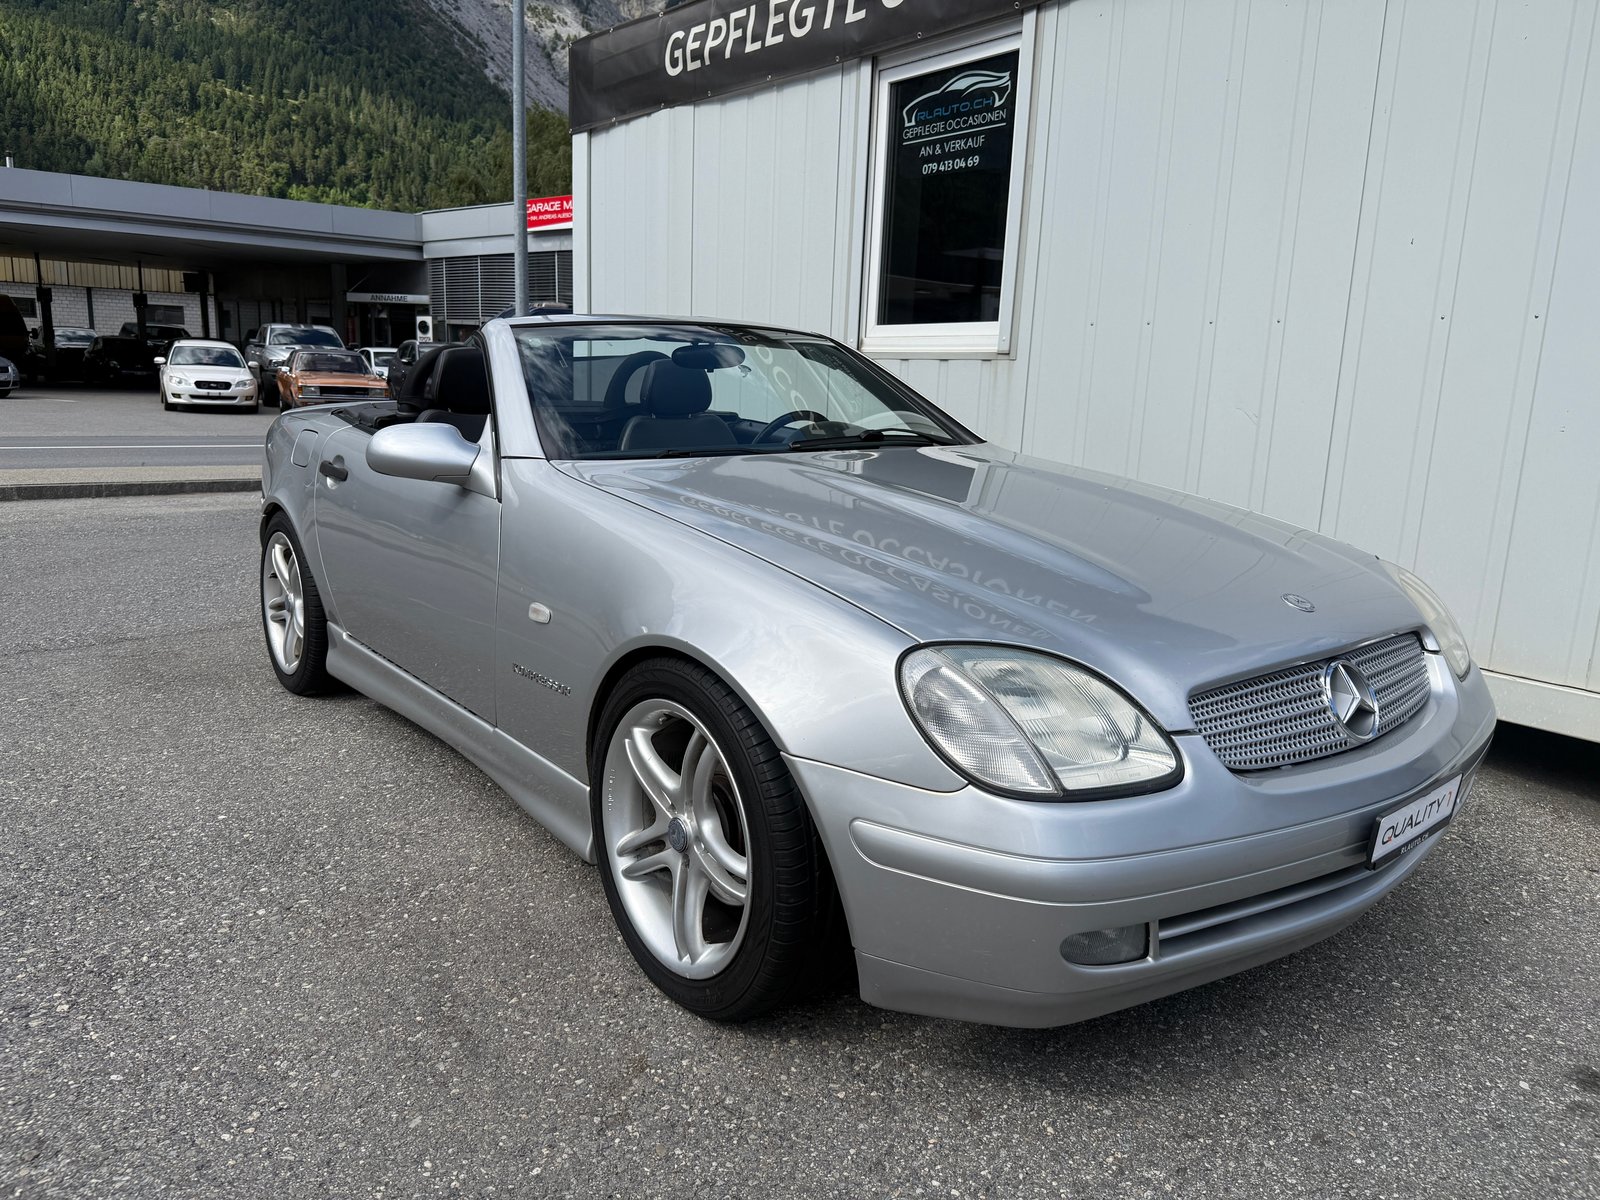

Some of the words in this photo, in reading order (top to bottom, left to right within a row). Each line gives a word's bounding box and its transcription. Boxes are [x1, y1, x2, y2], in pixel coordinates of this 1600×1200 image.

[917, 97, 993, 121] RLAUTO.CH
[903, 121, 945, 140] GEPFLEGTE
[946, 109, 1007, 131] OCCASIONEN
[919, 145, 933, 157] AN
[935, 144, 942, 155] &
[944, 135, 985, 153] VERKAUF
[922, 163, 937, 175] 079
[939, 160, 953, 172] 413
[954, 158, 966, 169] 04
[967, 155, 979, 167] 69
[526, 201, 561, 213] GARAGE
[563, 200, 573, 210] M
[1382, 794, 1446, 845] QUALITY
